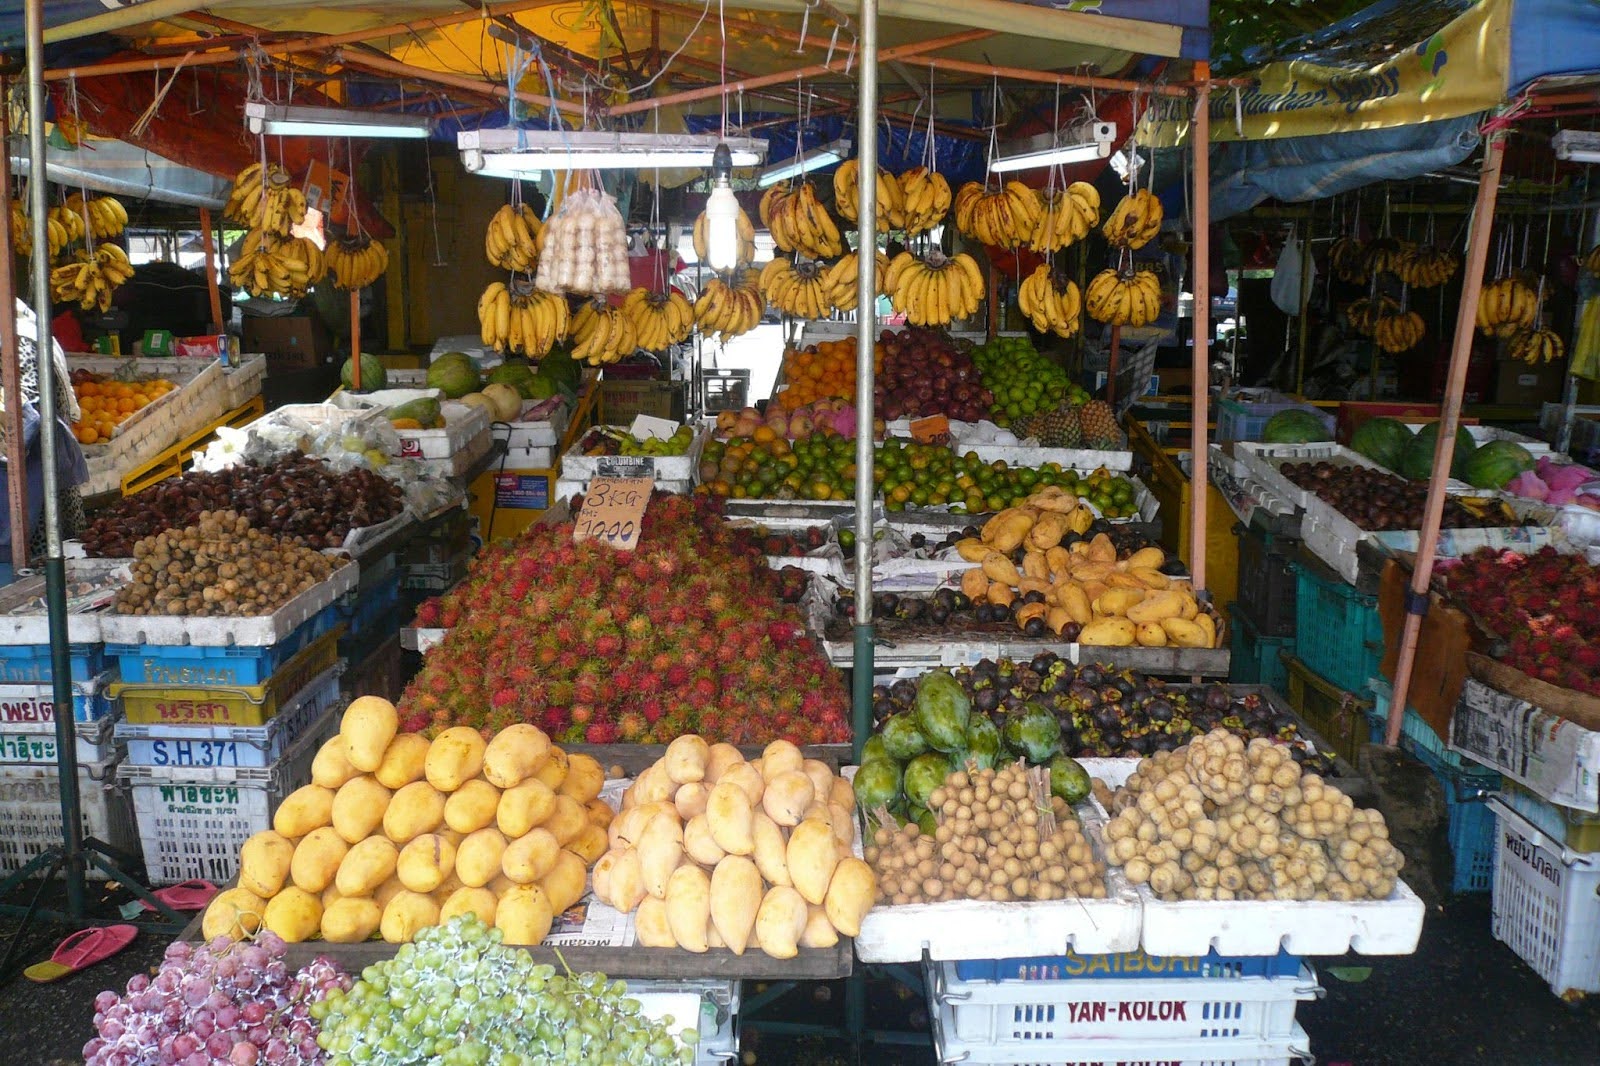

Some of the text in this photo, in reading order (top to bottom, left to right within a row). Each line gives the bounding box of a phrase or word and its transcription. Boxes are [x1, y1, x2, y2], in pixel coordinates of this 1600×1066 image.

[587, 483, 642, 507] 3 KG
[153, 739, 238, 766] S.H.371
[1067, 1001, 1188, 1024] YAN-KOLOK
